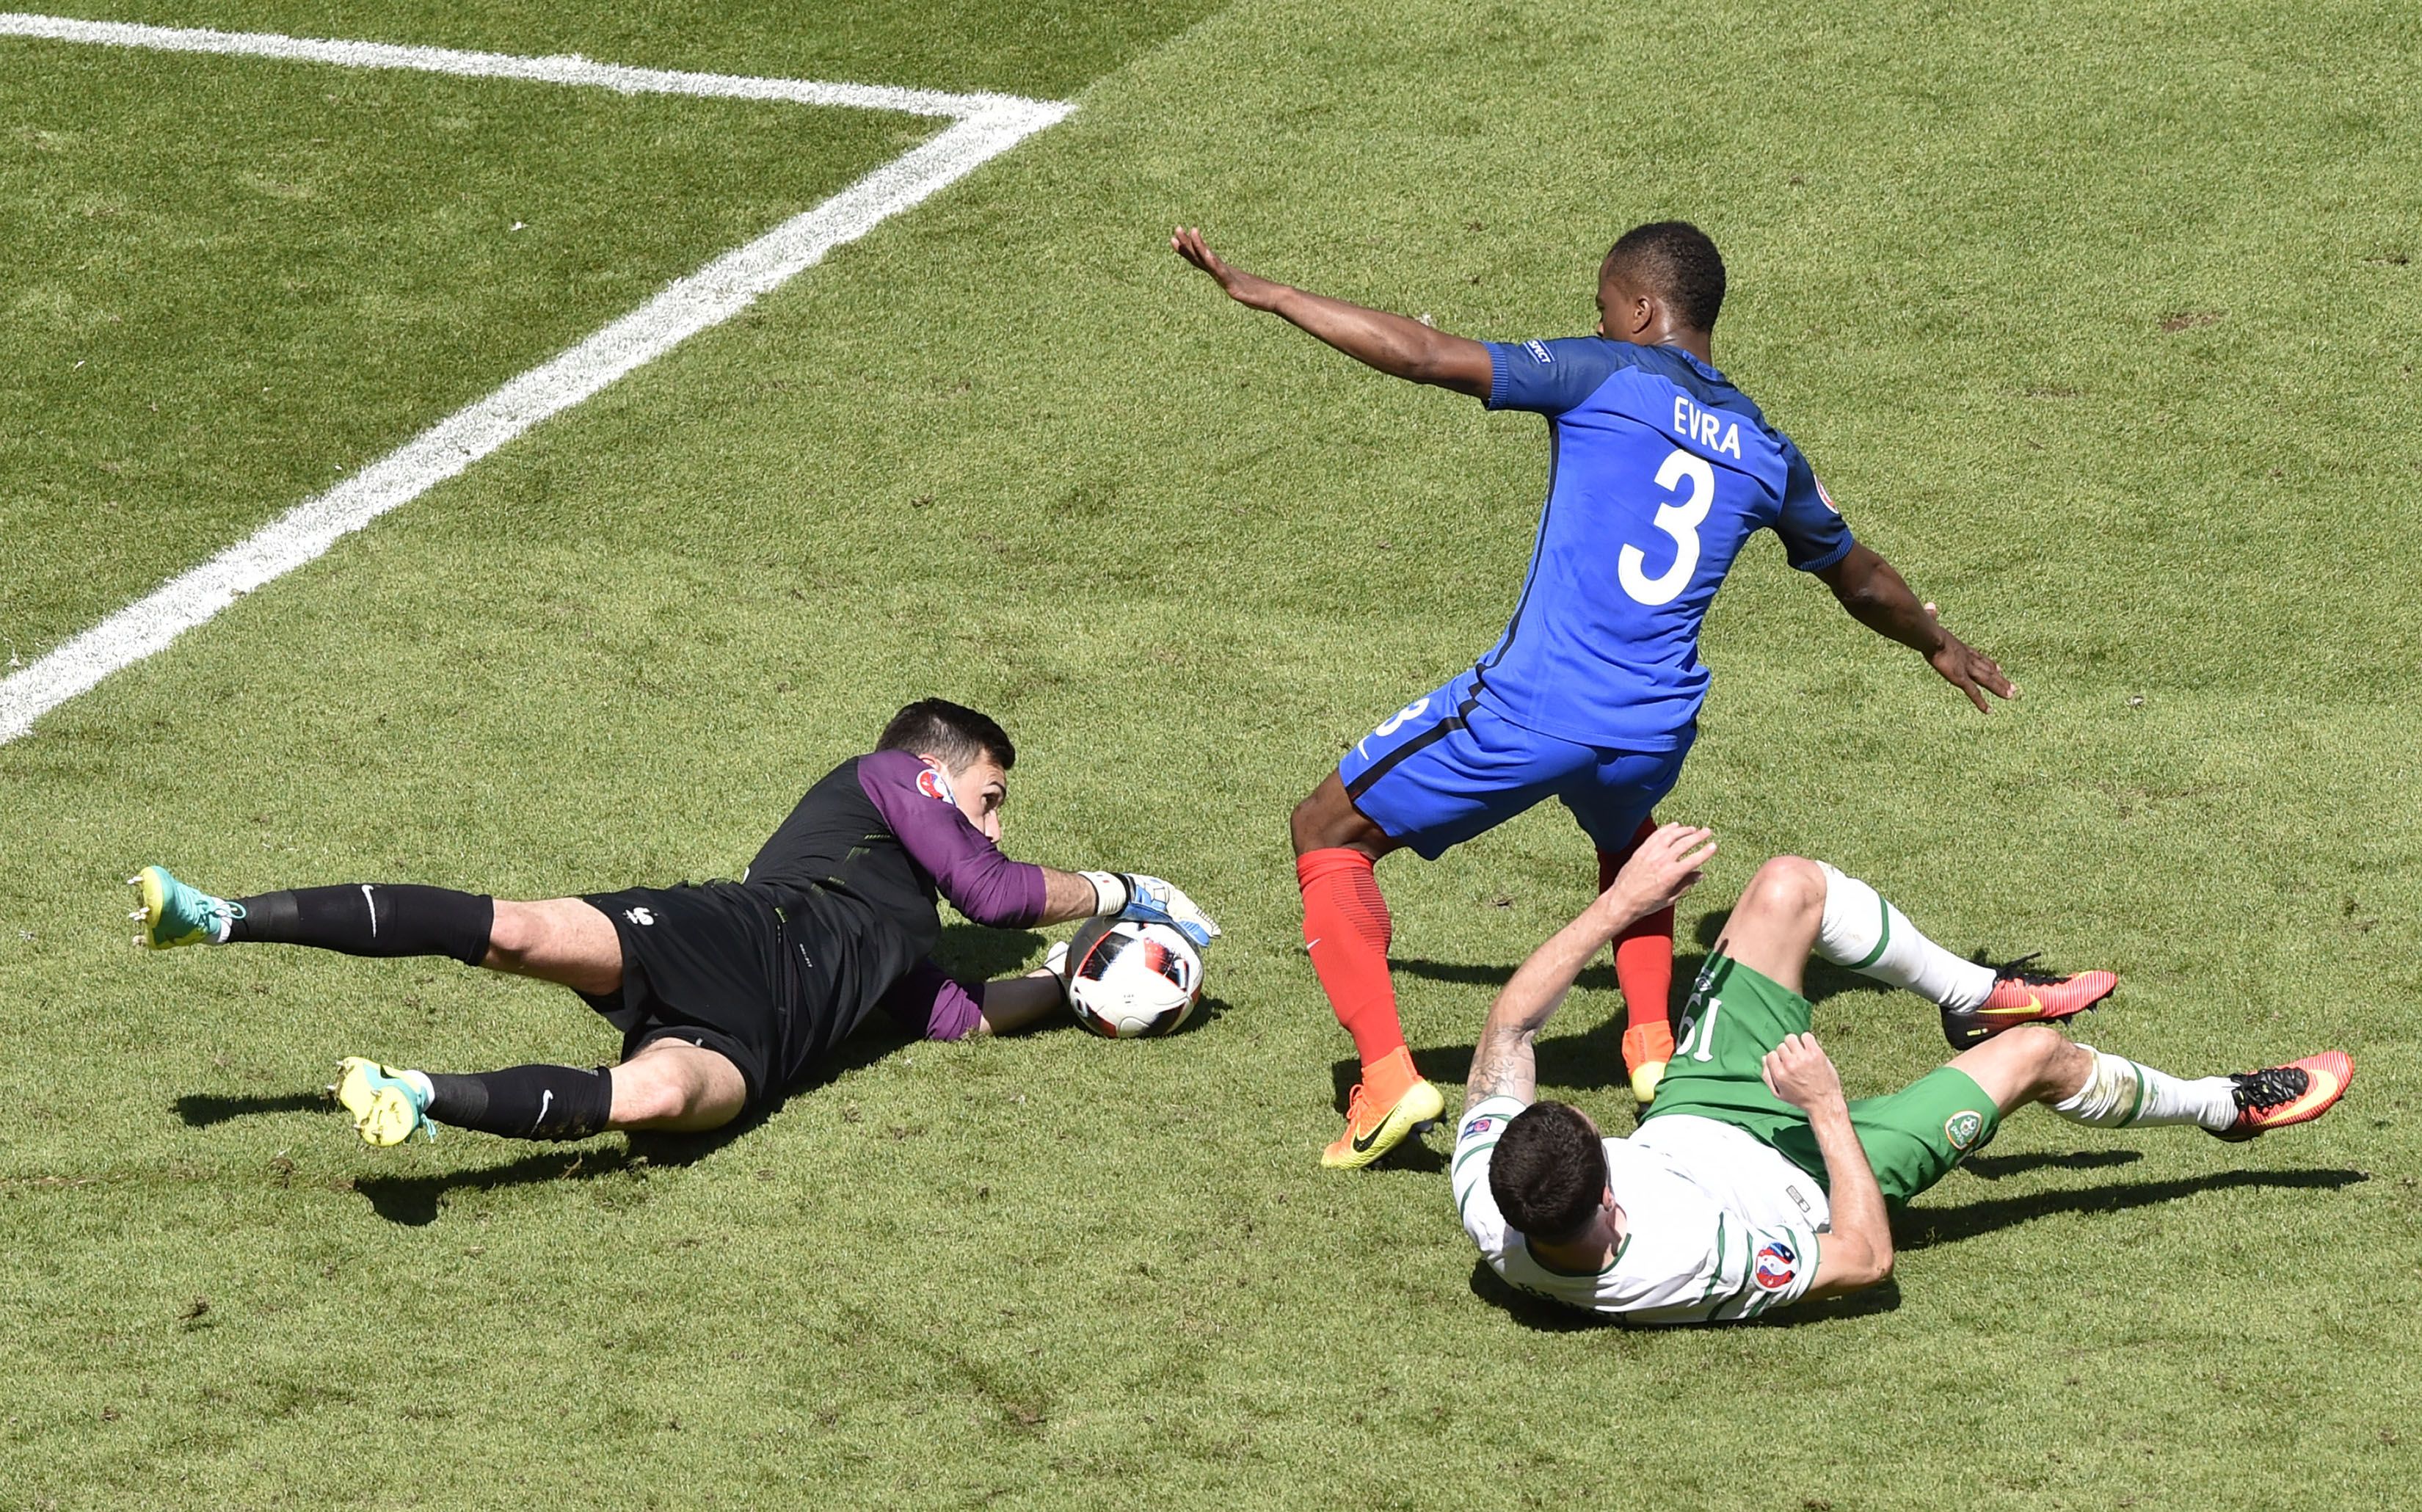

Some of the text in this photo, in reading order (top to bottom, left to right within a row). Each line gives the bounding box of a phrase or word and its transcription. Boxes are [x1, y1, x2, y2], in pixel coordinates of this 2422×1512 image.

[1527, 340, 1551, 363] SPECT
[1674, 396, 1741, 460] EVRA
[1618, 448, 1715, 606] 3
[1375, 697, 1430, 737] 3
